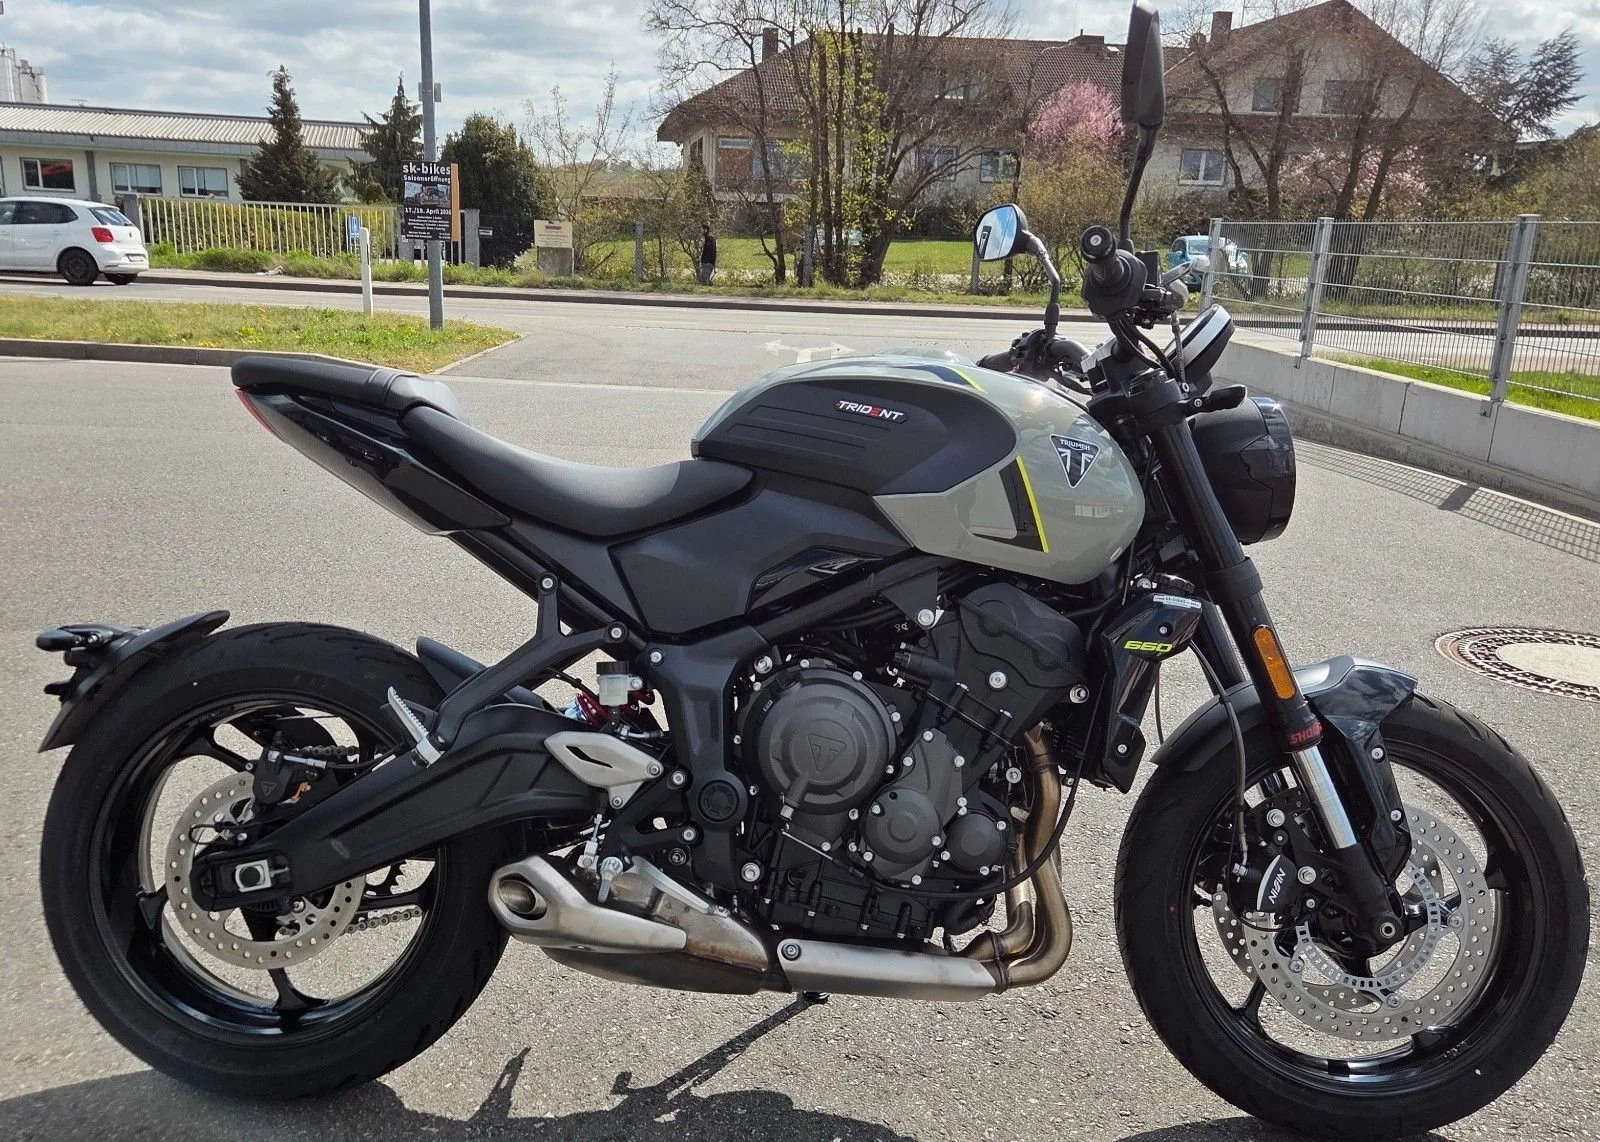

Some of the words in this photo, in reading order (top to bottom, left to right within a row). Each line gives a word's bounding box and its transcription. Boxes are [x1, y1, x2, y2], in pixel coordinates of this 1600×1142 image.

[402, 162, 451, 175] sk-bikes
[403, 175, 451, 184] Saisoneröffnung
[426, 208, 439, 216] April
[838, 400, 904, 420] TRIDENT
[1059, 439, 1091, 451] TRIUMPH
[1123, 640, 1173, 653] 660
